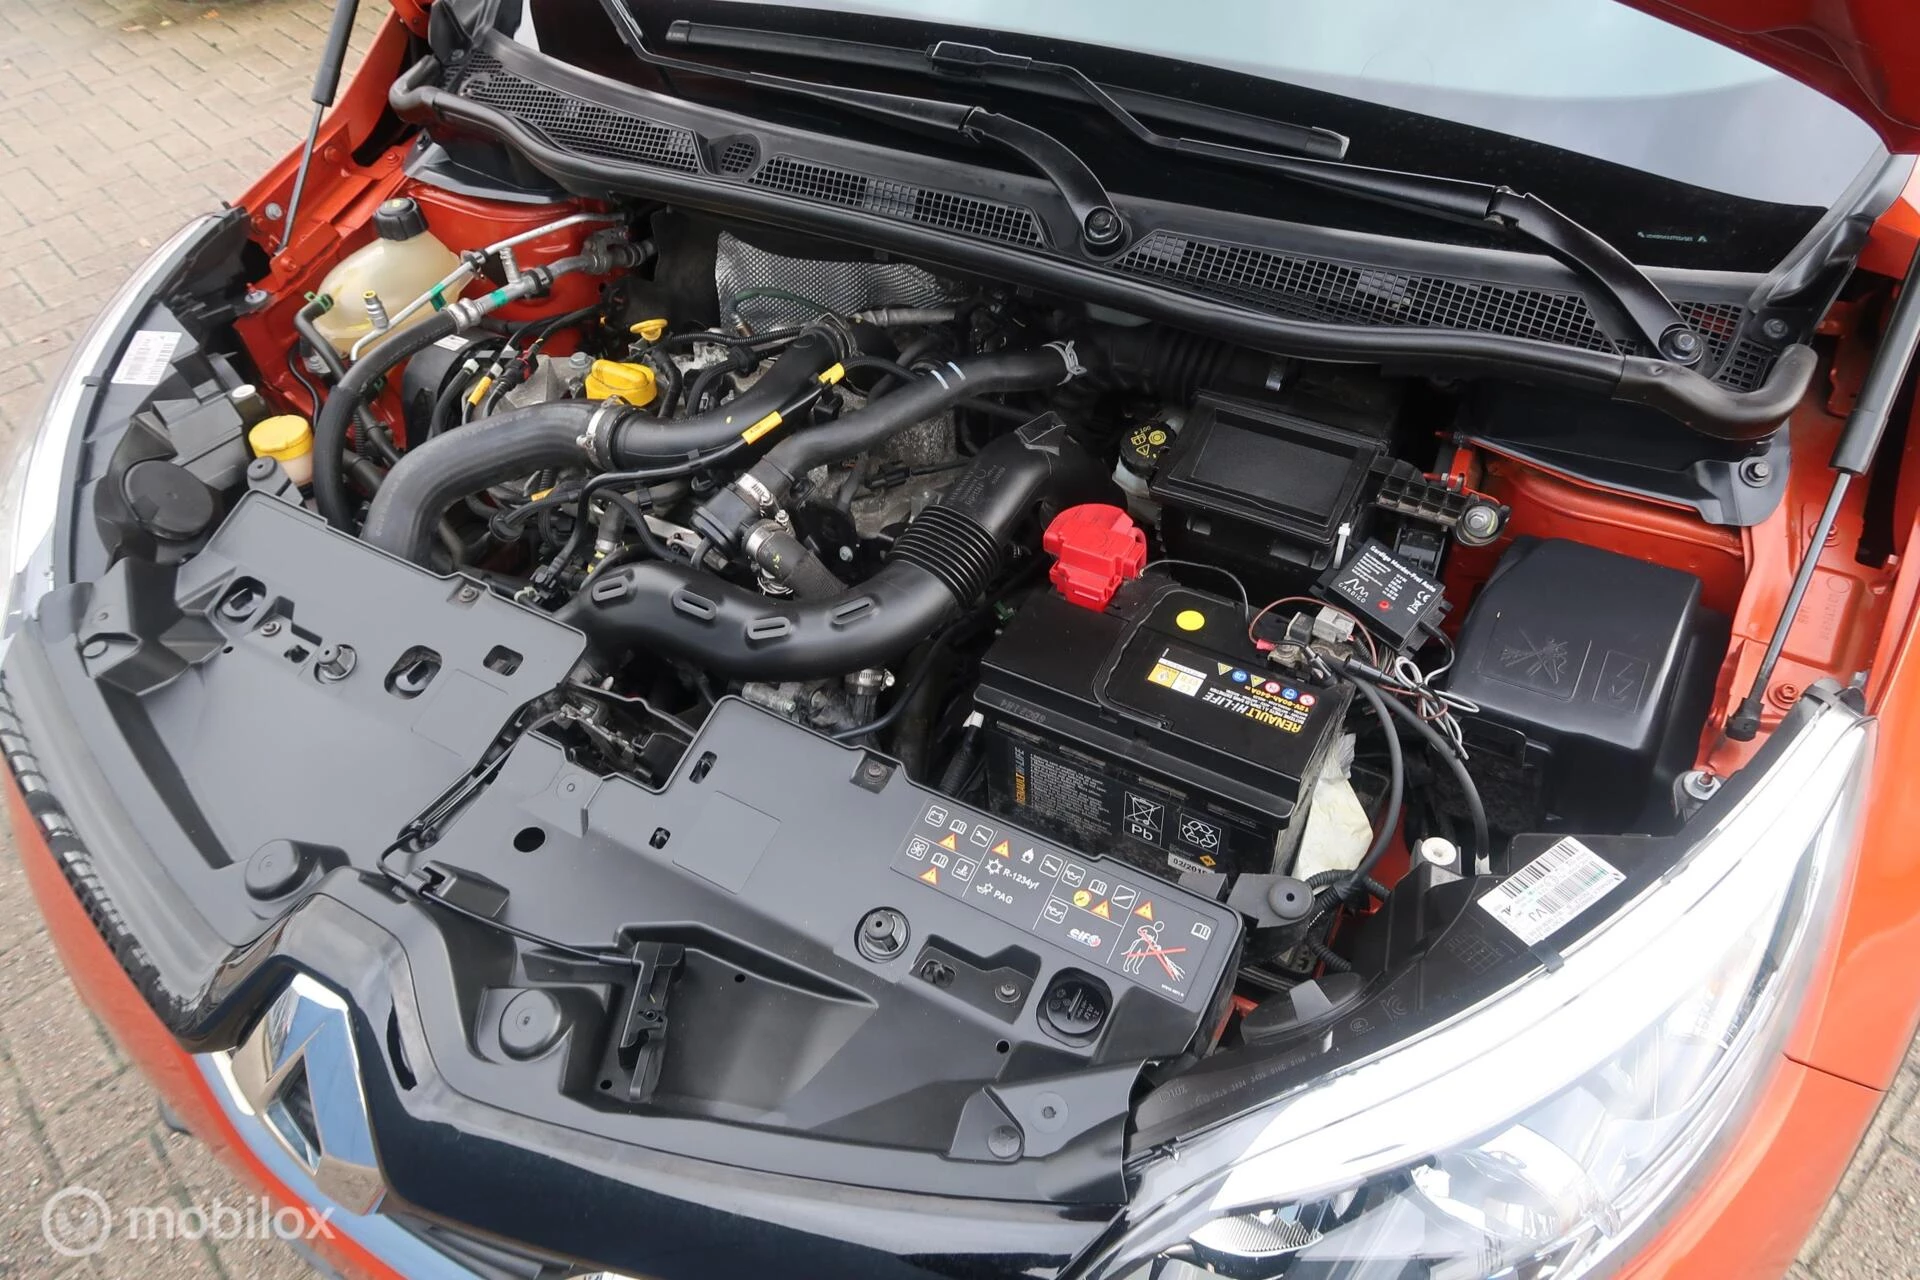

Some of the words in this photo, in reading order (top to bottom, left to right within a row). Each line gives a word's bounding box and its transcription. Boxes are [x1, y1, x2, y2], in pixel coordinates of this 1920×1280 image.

[1370, 545, 1391, 562] Gardigo
[1422, 581, 1436, 592] Auto
[1246, 709, 1302, 733] RENAULT
[1131, 824, 1153, 841] Pb
[1003, 868, 1039, 890] R-1234yf
[993, 890, 1013, 905] PAG
